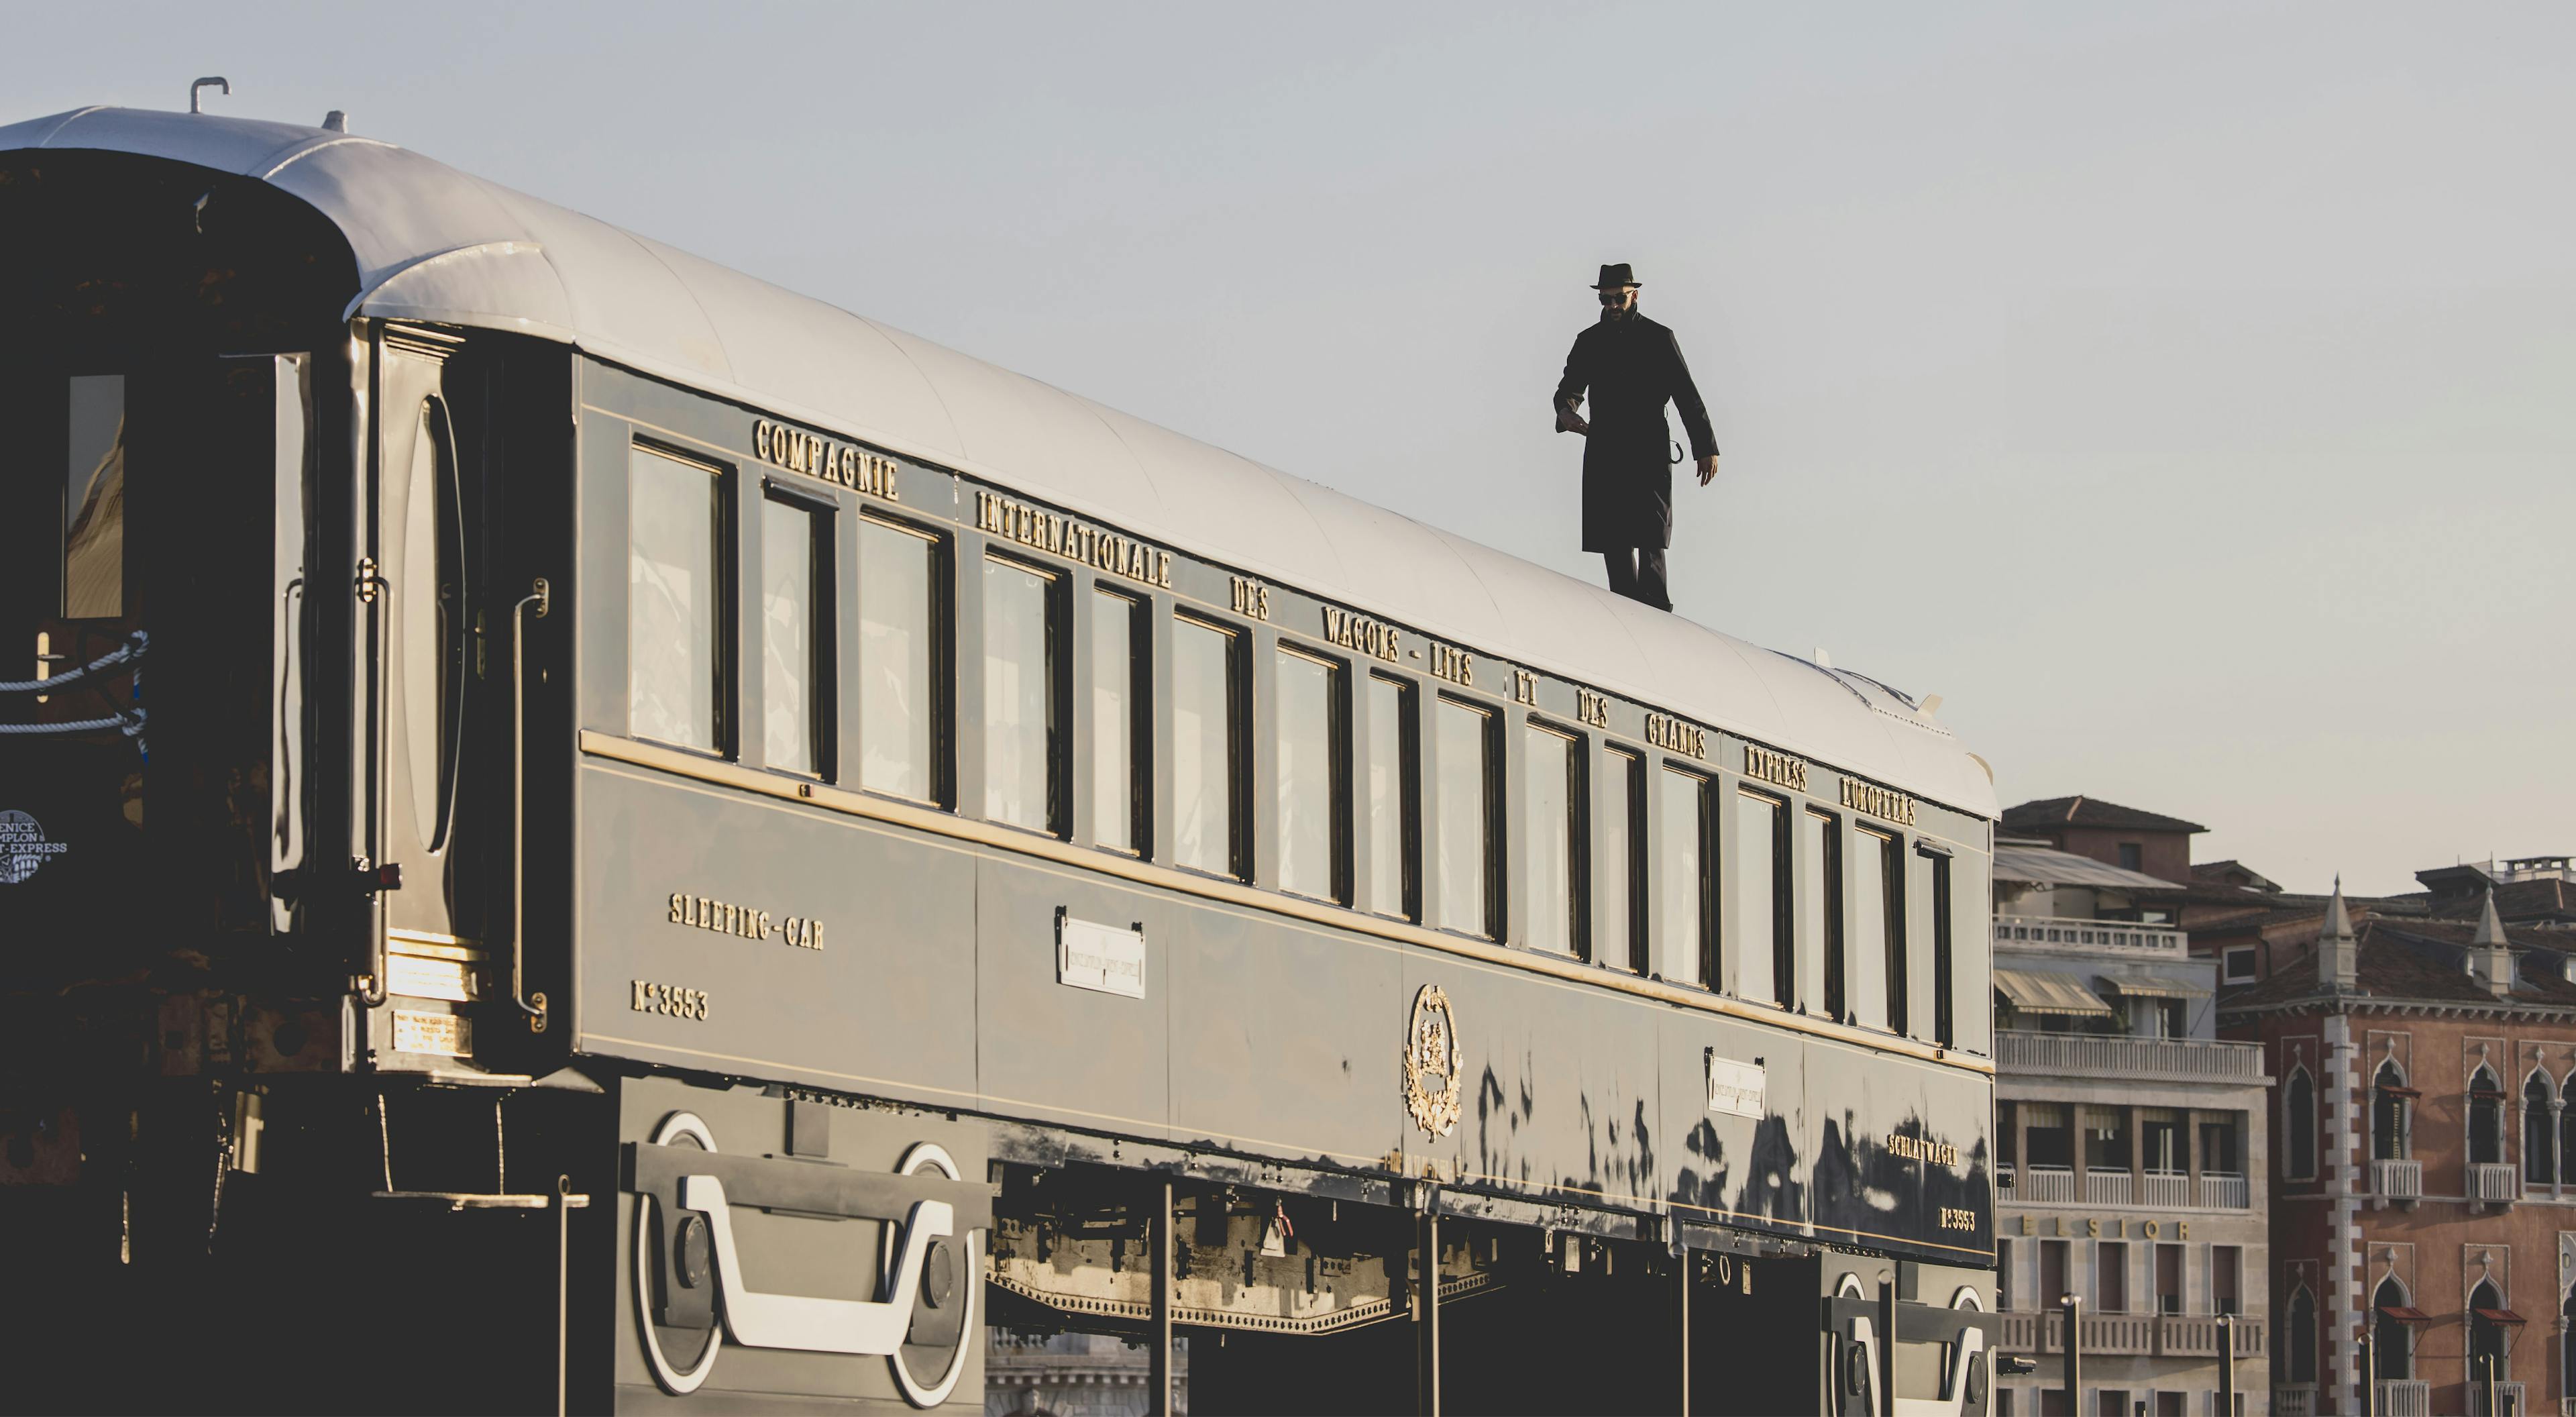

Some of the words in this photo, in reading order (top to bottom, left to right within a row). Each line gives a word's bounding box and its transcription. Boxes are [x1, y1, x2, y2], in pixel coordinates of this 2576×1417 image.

[755, 419, 900, 502] COMPAGNIE
[977, 490, 1172, 589] INTERNATIONALE
[1231, 576, 1269, 621] DES
[1323, 606, 1399, 663] WAGONS
[1430, 641, 1473, 686] LITS
[1515, 670, 1538, 705] ET
[1576, 689, 1609, 729] DES
[1646, 713, 1707, 759] GRANDS
[1744, 745, 1807, 792] EXPRESS
[1840, 778, 1916, 826] EUROPEENS
[669, 893, 824, 951] SLEEPING-CAR
[1888, 1135, 1958, 1166] SCHLAFWAGEN
